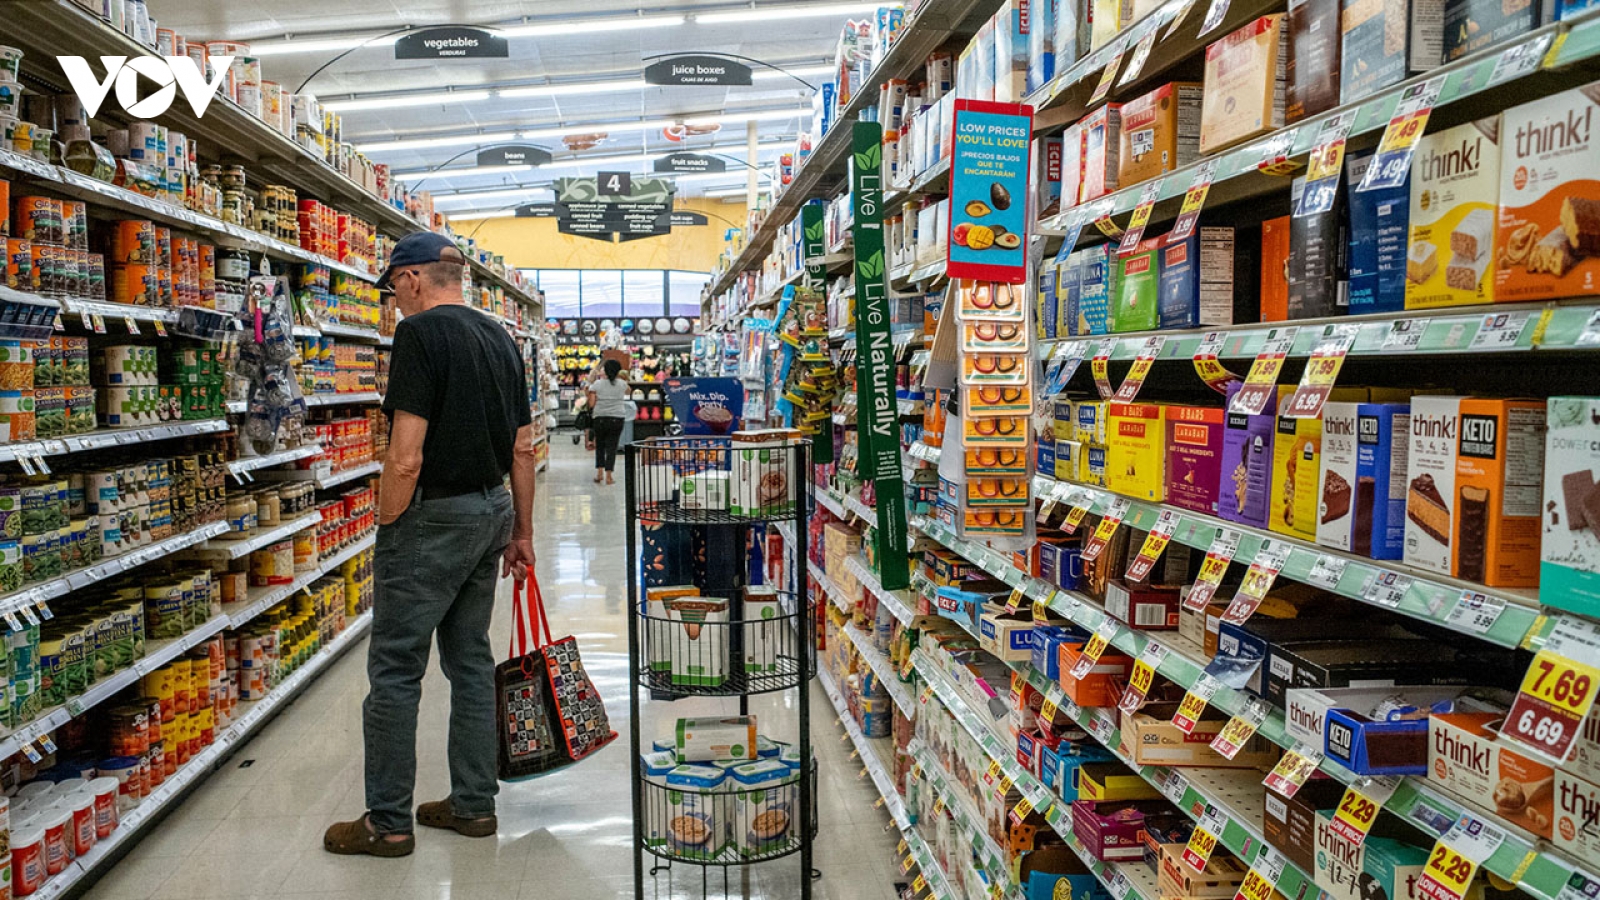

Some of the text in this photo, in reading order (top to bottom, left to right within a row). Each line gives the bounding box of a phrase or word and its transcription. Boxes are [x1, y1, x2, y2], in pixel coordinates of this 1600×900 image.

[424, 37, 479, 50] vegetables
[672, 65, 726, 76] juice boxes
[960, 123, 1026, 137] LOW PRICES
[1387, 120, 1419, 142] 7.49
[1515, 105, 1593, 159] think!
[956, 134, 1029, 149] YOU'LL LOVE!
[504, 152, 525, 160] beans
[671, 158, 709, 167] fruit snacks
[996, 154, 1021, 162] BAJOS
[1420, 137, 1481, 182] think!
[1049, 150, 1060, 180] CLIF
[606, 174, 621, 192] 4
[860, 175, 880, 216] Live
[809, 243, 824, 273] Lie
[1585, 272, 1592, 284] 5
[864, 283, 884, 325] Live
[1254, 361, 1277, 375] 7.99
[1310, 360, 1336, 375] 7.99
[869, 331, 895, 436] Naturally
[689, 391, 730, 401] Mix. Dip.
[698, 400, 727, 409] Party.
[1295, 393, 1321, 410] 6.99
[1080, 409, 1095, 419] LUNA
[1128, 406, 1143, 417] BARS
[1185, 408, 1204, 420] BARS
[1119, 424, 1144, 434] LARABAR
[1177, 428, 1205, 439] LARABAR
[1325, 416, 1355, 436] think!
[1359, 417, 1377, 434] KETO
[1413, 414, 1458, 439] think!
[1463, 419, 1495, 443] KETO
[1090, 451, 1105, 461] LUNA
[1149, 538, 1164, 551] 7.99
[1206, 559, 1223, 576] 7.99
[1015, 633, 1033, 645] LU
[1134, 664, 1151, 689] 9.79
[1532, 660, 1590, 707] 7.69
[1289, 702, 1322, 736] think!
[1329, 721, 1351, 748] KETO
[1517, 710, 1564, 746] 6.69
[1186, 734, 1214, 742] LARA
[1434, 727, 1491, 776] think!
[1279, 753, 1310, 779] 3/5.0
[1341, 792, 1376, 824] 2.29
[1344, 825, 1363, 843] PRICE
[1318, 822, 1362, 871] think!
[1430, 847, 1472, 885] 2.29
[1244, 871, 1271, 900] 3/5.00
[1420, 877, 1435, 892] LOW
